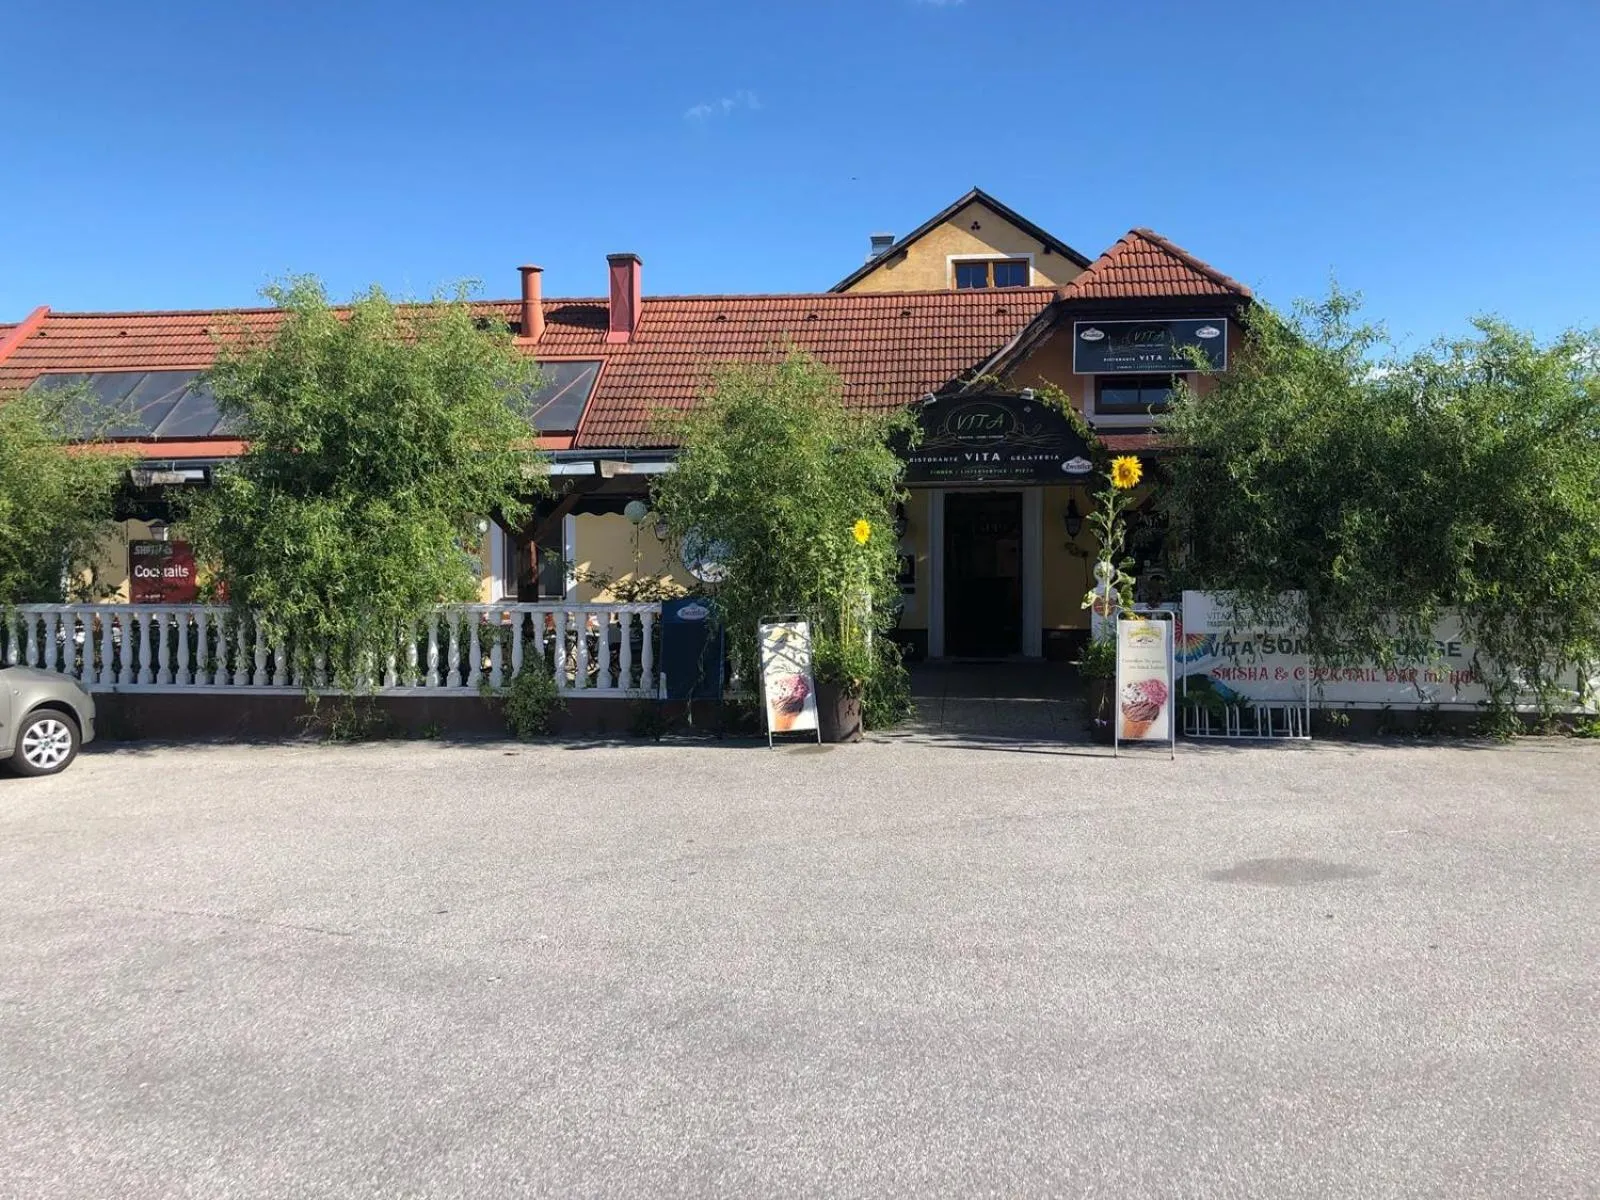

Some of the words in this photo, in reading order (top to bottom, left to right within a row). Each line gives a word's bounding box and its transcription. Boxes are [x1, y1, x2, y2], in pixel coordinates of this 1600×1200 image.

[1139, 354, 1163, 362] VITA
[957, 413, 1005, 430] VITA
[965, 452, 1000, 462] VITA
[1208, 640, 1256, 657] VITA
[1211, 665, 1269, 681] SHISHA
[1274, 666, 1289, 681] &
